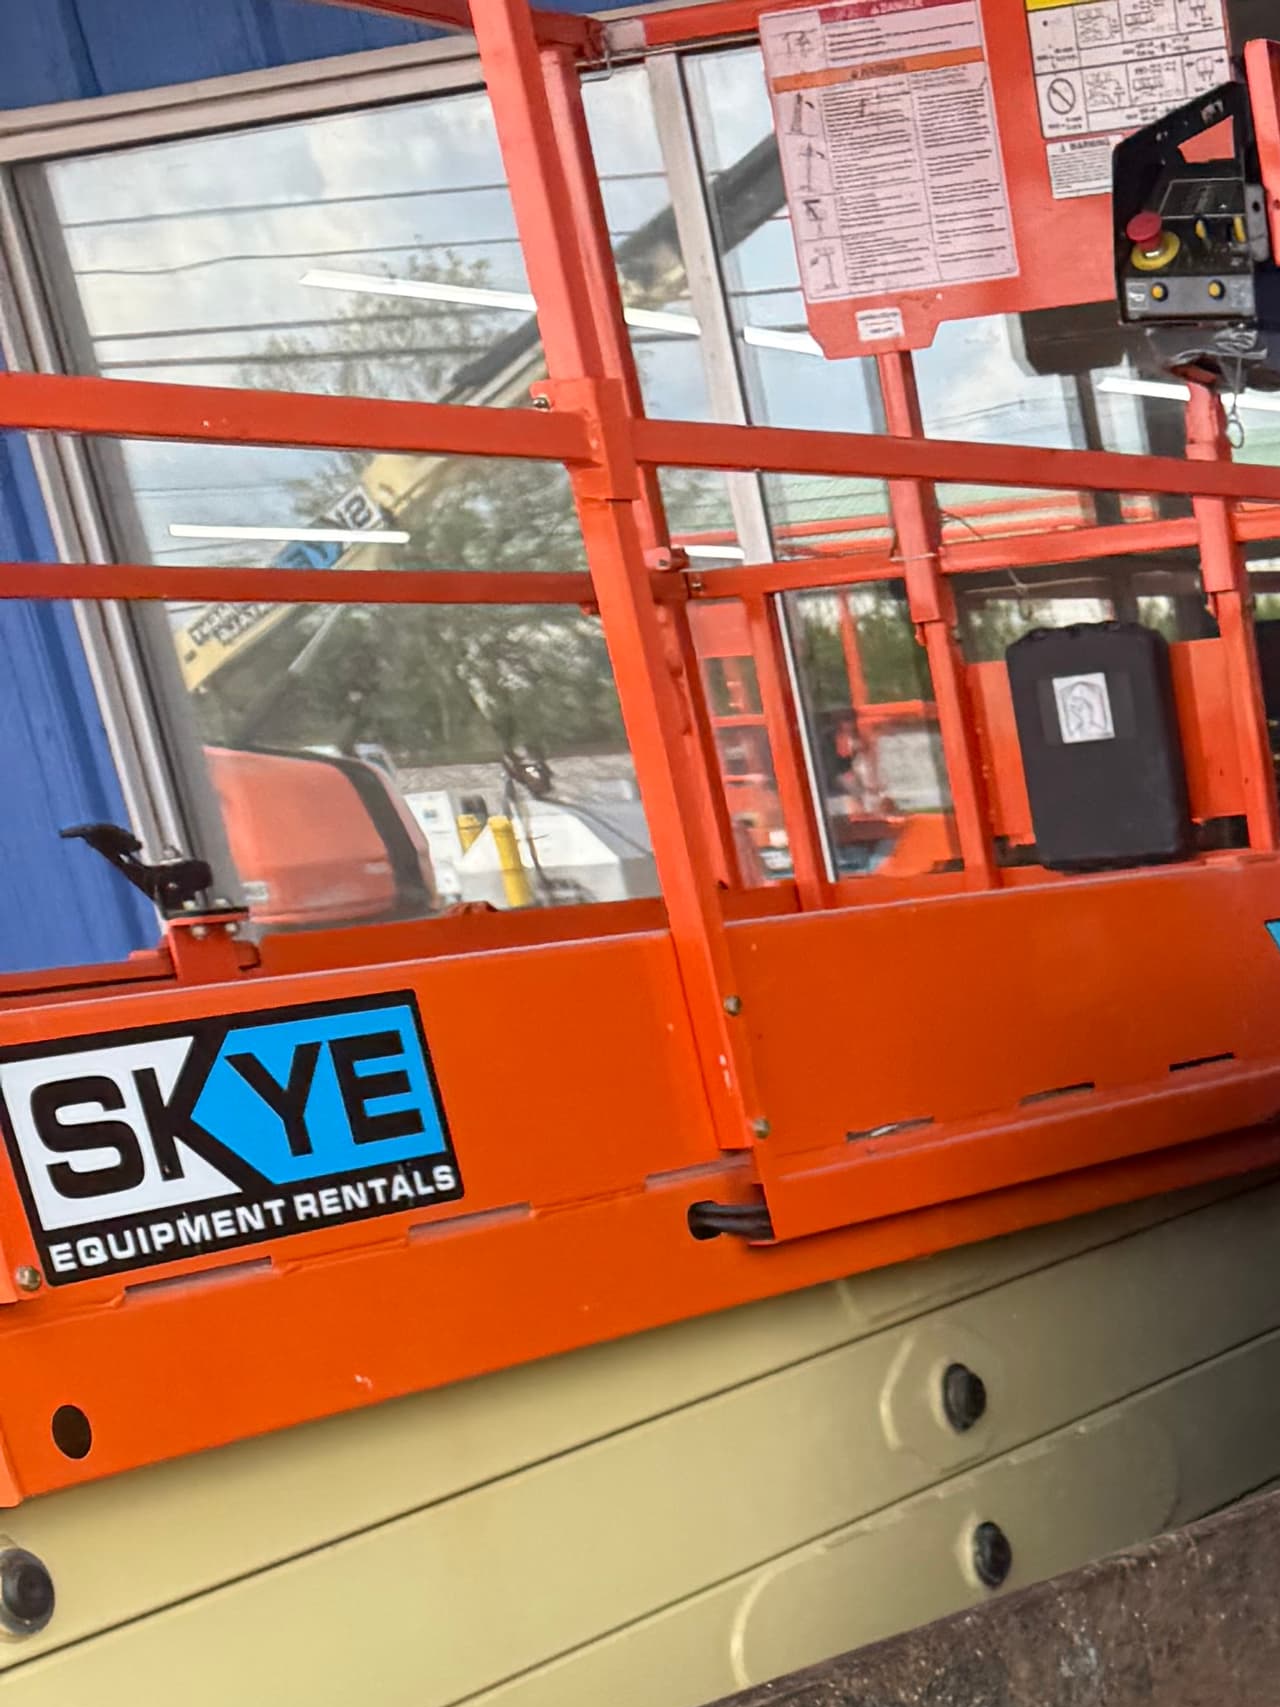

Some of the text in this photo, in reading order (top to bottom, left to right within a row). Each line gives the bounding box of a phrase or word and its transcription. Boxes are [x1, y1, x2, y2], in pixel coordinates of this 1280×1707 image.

[29, 1029, 426, 1200] SKYE
[48, 1165, 457, 1275] EQUIPMENT RENTALS
